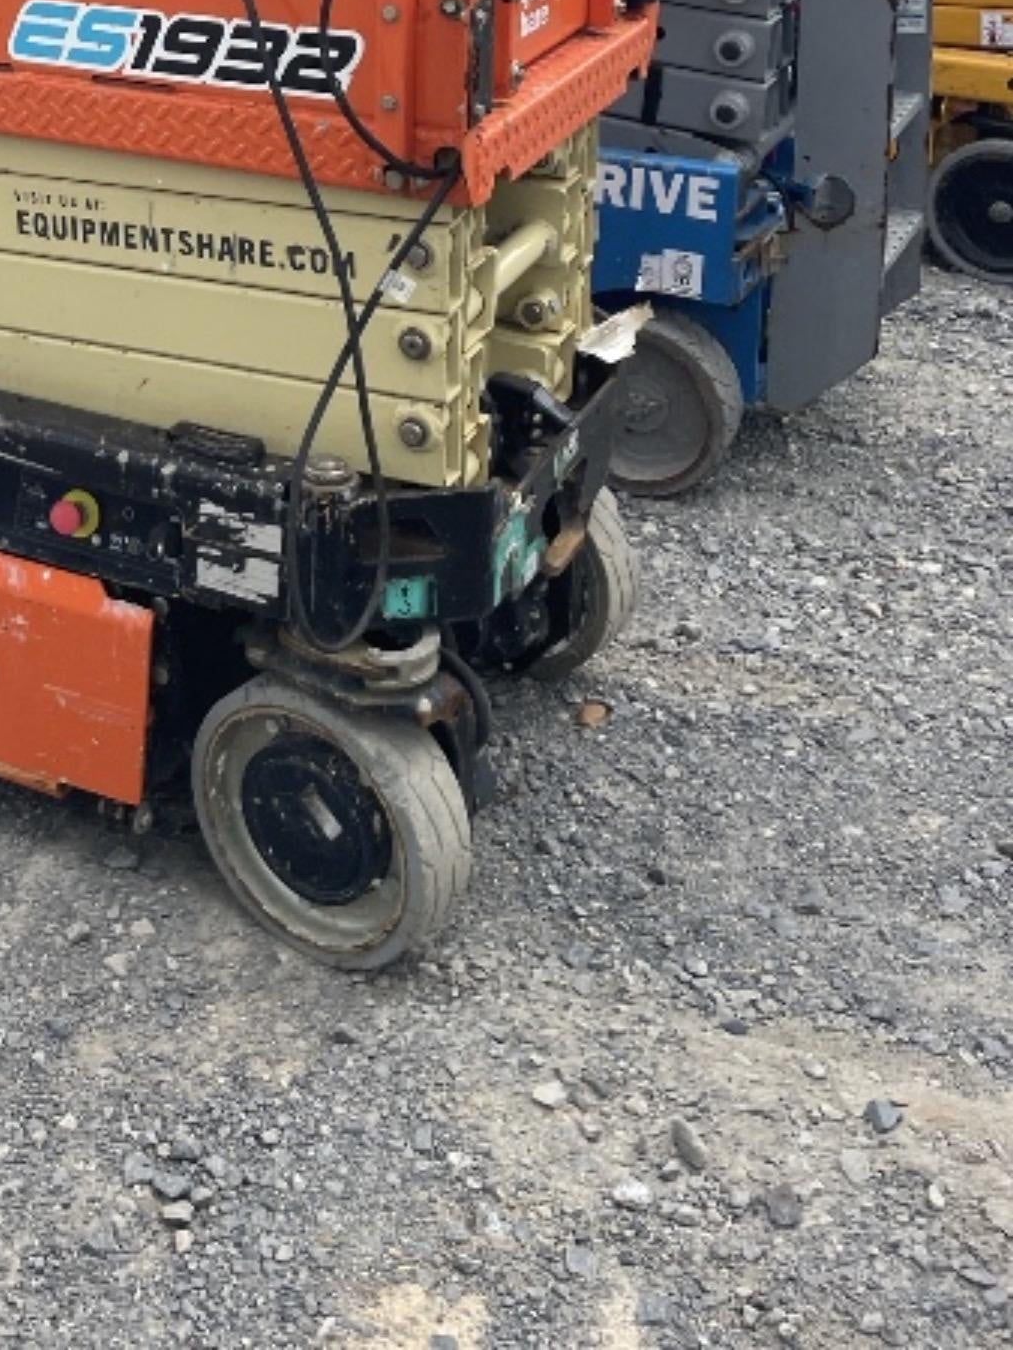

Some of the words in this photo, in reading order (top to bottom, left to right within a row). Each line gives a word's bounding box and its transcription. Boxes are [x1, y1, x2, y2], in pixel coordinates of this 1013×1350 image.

[9, 0, 362, 96] ES1932
[593, 162, 721, 224] RIVE
[15, 208, 356, 280] EQUIPMENTSHARE.COM
